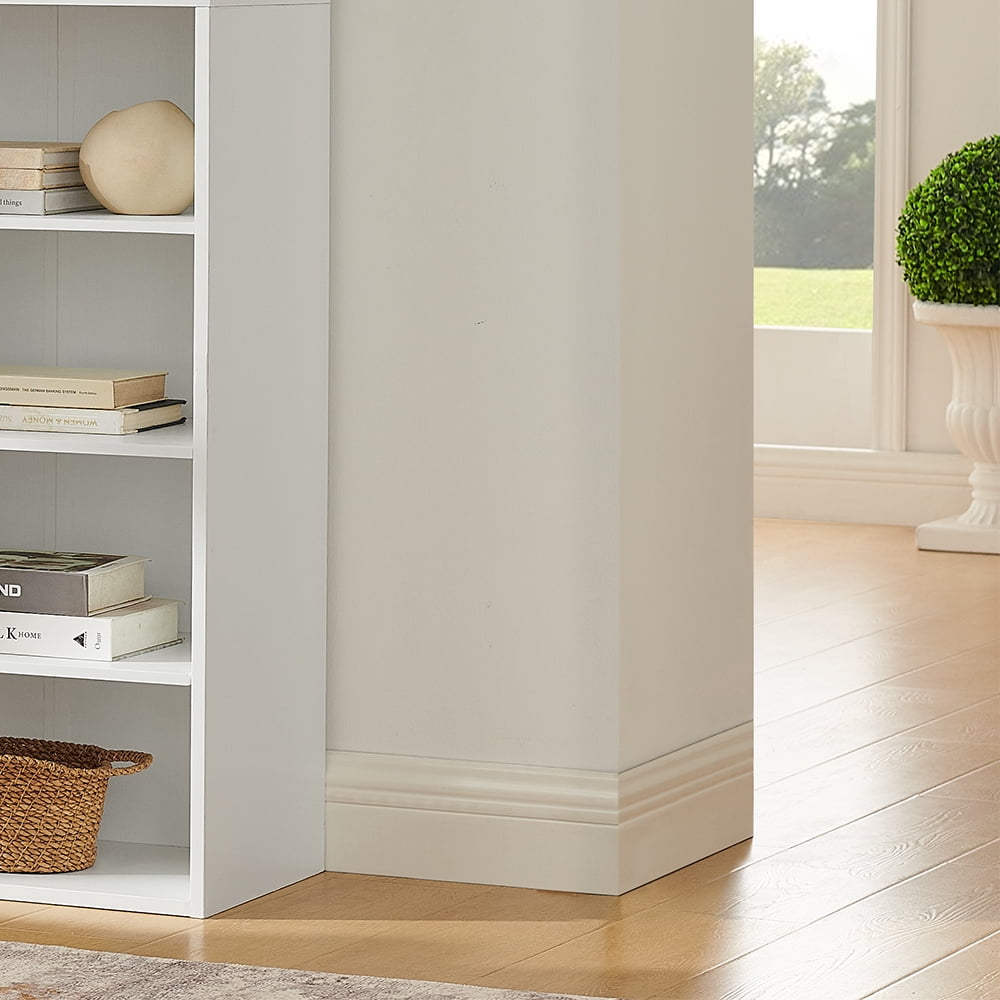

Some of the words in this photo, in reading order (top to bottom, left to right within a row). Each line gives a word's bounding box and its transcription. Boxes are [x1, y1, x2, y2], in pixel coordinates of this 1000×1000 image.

[3, 199, 22, 207] things
[22, 415, 54, 424] MONEY
[64, 417, 97, 427] WOMEN
[18, 631, 41, 640] HOME
